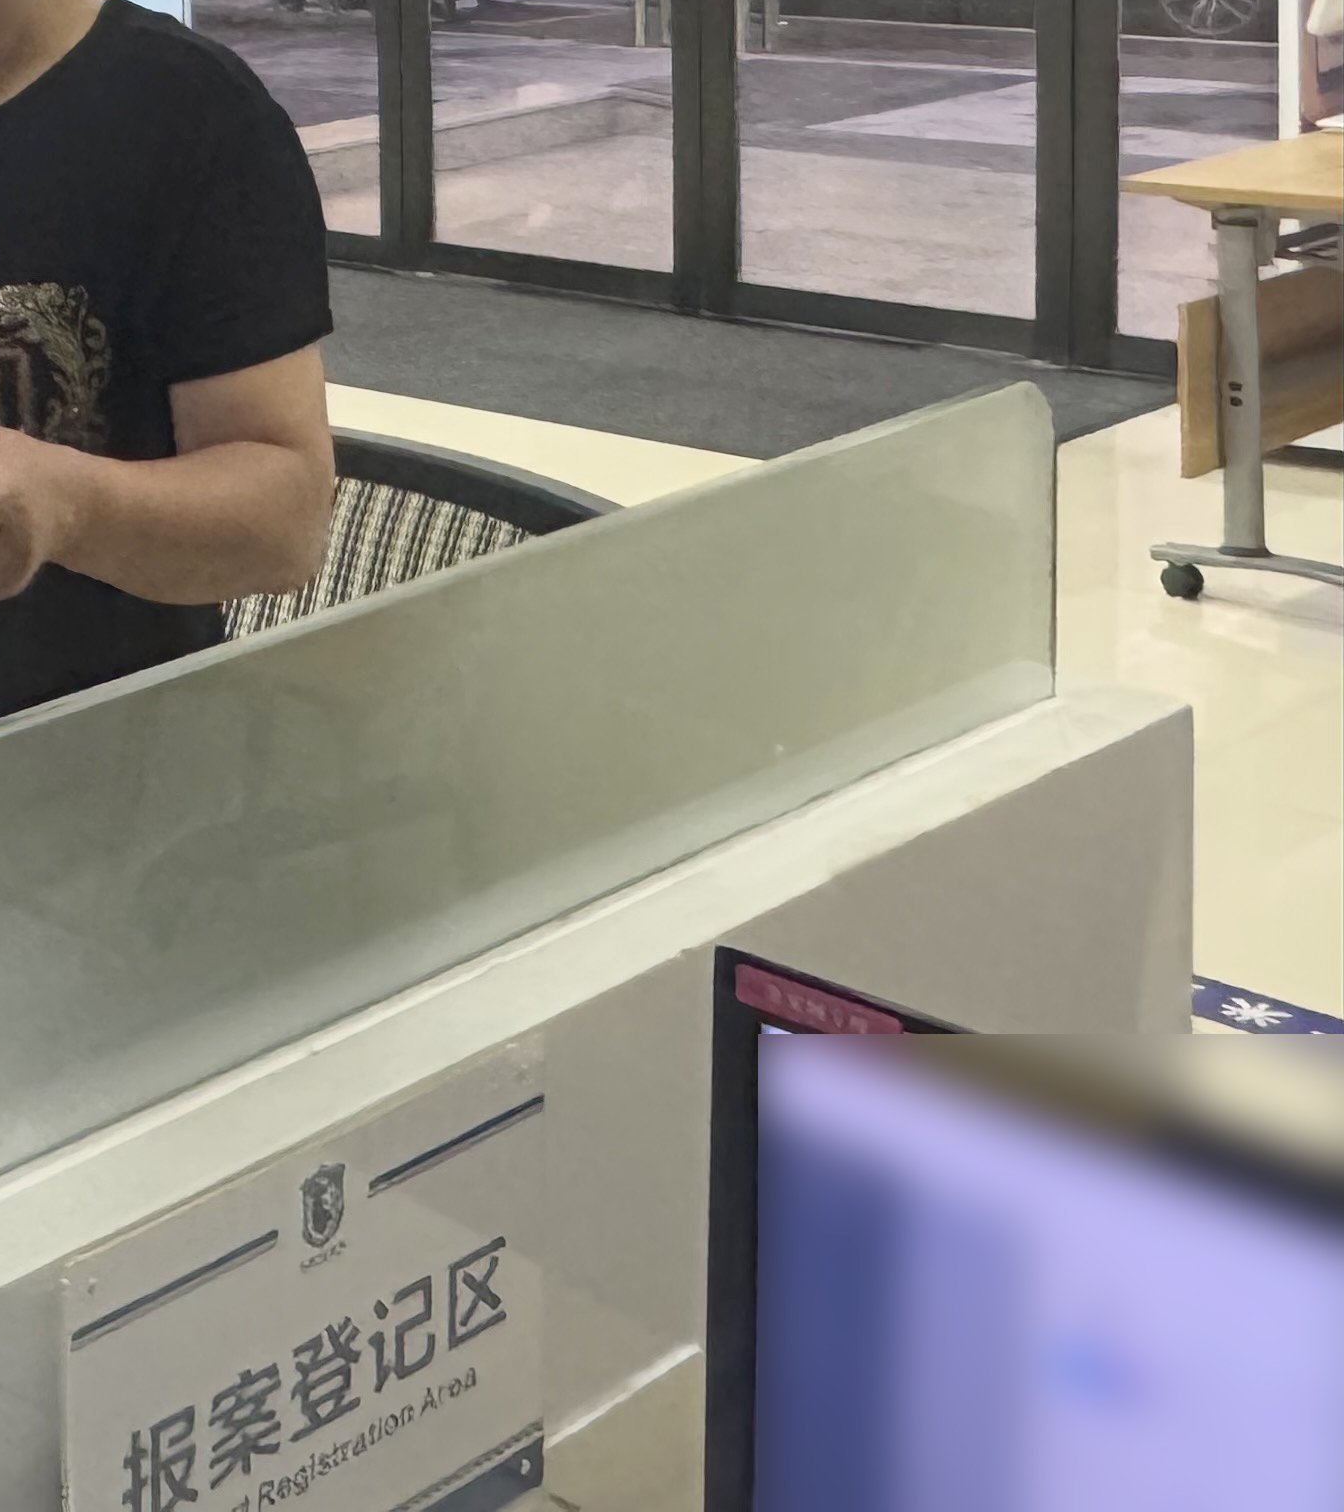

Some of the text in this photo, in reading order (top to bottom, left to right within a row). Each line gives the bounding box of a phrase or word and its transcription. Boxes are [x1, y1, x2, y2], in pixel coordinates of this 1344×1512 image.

[122, 1236, 507, 1512] 报案登记区
[258, 1367, 477, 1512] Registration Area
